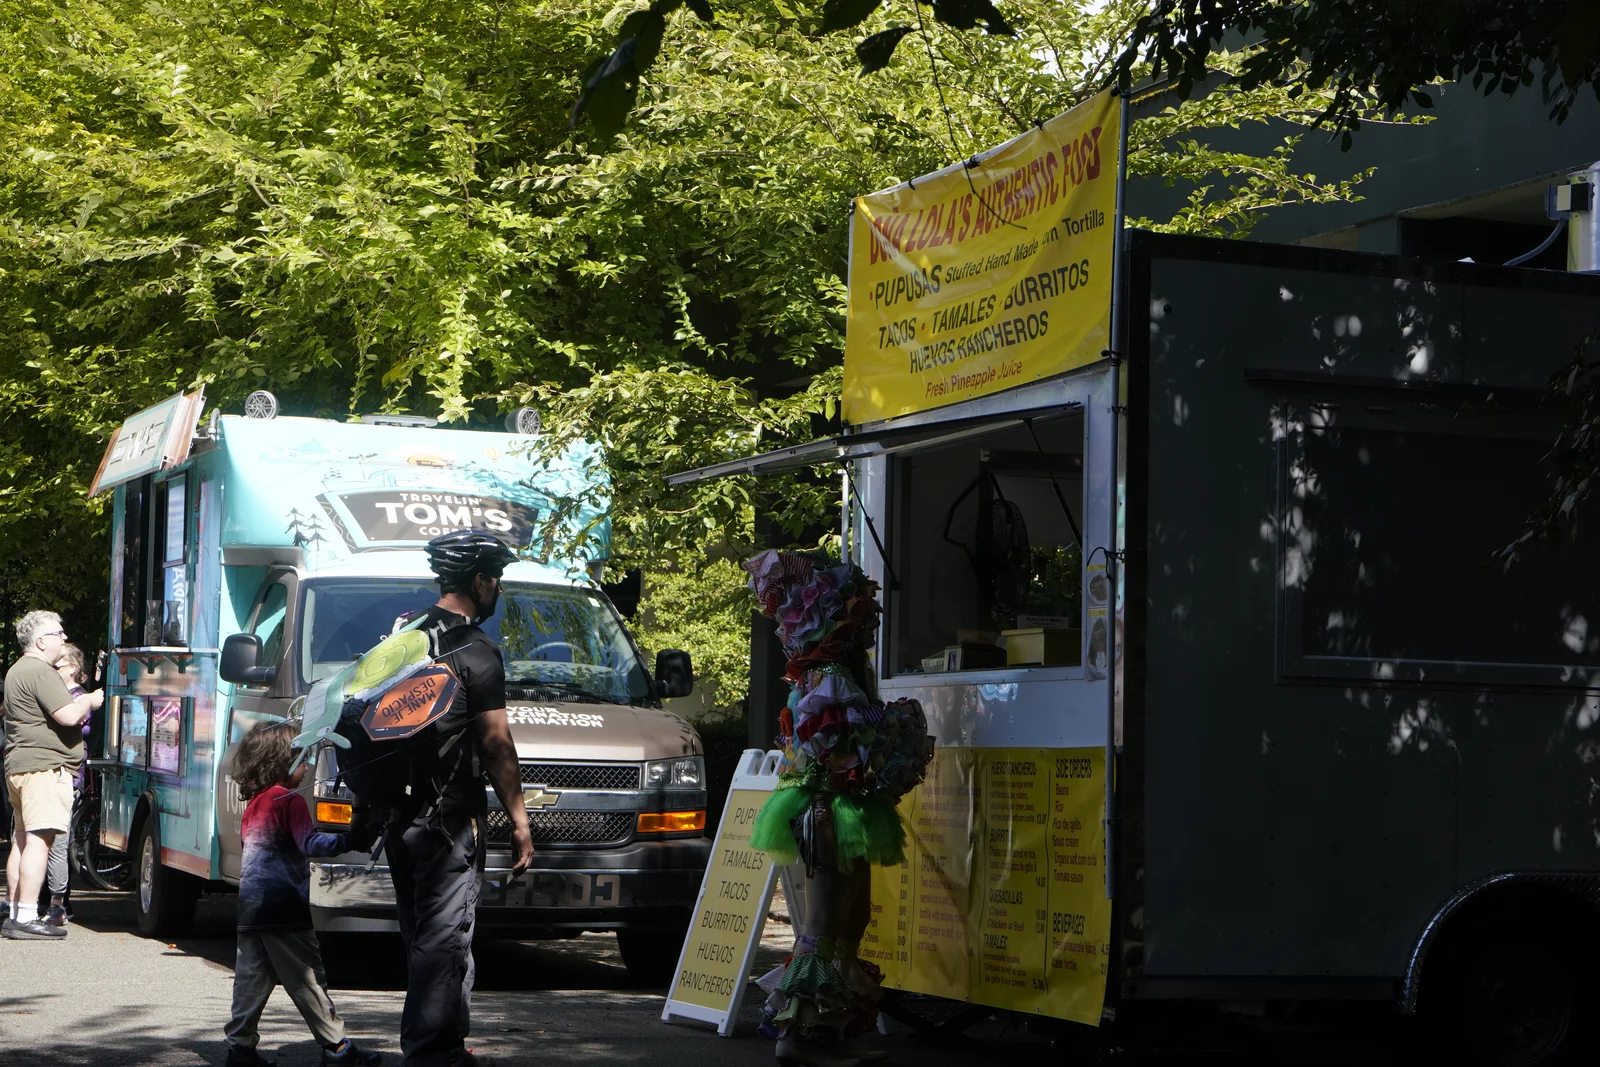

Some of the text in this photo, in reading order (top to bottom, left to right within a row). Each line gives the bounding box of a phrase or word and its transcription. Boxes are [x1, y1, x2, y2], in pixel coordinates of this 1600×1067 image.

[905, 193, 973, 253] LOLA'S
[970, 151, 1060, 238] AUTHENTIC
[874, 264, 942, 310] PUPUSAS
[944, 253, 983, 284] Stuffed
[985, 248, 1010, 272] Hand
[1014, 236, 1039, 261] Made
[1061, 208, 1105, 237] Tortilla
[878, 258, 1090, 350] TACOS TAMALES BURRITOS
[910, 310, 1049, 375] HUEVOS RANCHEROS
[925, 359, 1023, 399] Fresh Pineapple Juice
[399, 492, 483, 506] TRAVELIN'
[374, 502, 513, 532] TOM'S
[418, 526, 472, 536] COF
[381, 677, 436, 718] DESPACIO
[391, 688, 437, 725] MANEJE
[1055, 758, 1092, 779] SIDE ORDERS
[1055, 783, 1070, 796] Beans
[1054, 800, 1064, 813] Rice
[1052, 817, 1062, 830] Pico
[1063, 818, 1069, 830] de
[1052, 834, 1079, 848] Sour cream
[722, 849, 765, 871] TAMALES
[1053, 869, 1084, 883] Tomato sauce
[718, 880, 751, 902] TACOS
[989, 888, 1023, 905] QUESADILLAS
[989, 905, 1008, 917] Cheese
[701, 910, 749, 935] BURRITOS
[986, 918, 1007, 930] Chicken
[1008, 922, 1014, 931] or
[1053, 912, 1086, 936] BEVERAGES
[697, 940, 735, 965] HUEVOS
[984, 933, 1008, 950] TAMALES
[678, 969, 735, 998] RANCHEROS
